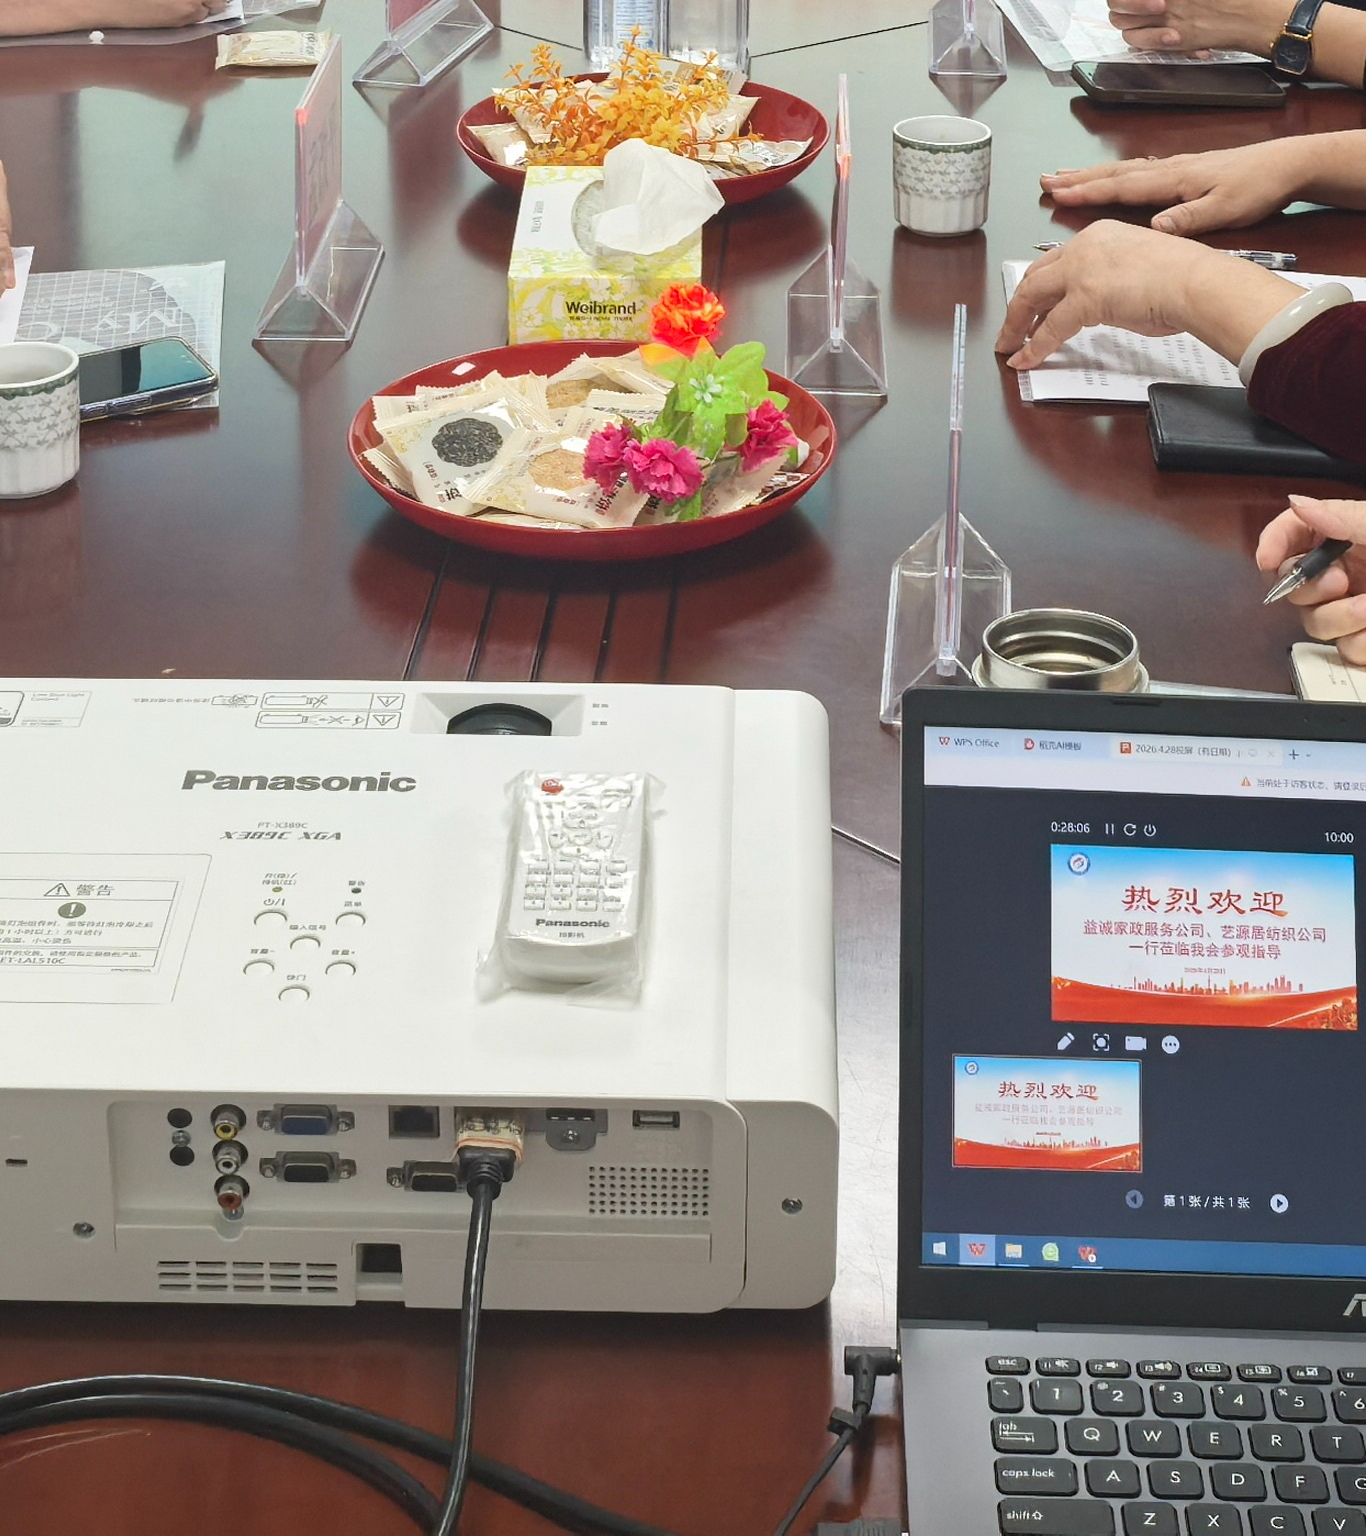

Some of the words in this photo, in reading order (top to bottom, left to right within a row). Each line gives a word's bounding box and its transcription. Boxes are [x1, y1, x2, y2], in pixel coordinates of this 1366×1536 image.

[566, 301, 636, 315] Weibrand
[974, 737, 1000, 749] Office
[182, 770, 417, 792] Panasonic
[1051, 822, 1090, 834] 0:28:06
[298, 831, 342, 841] XGA
[1324, 831, 1354, 844] 10:00
[76, 884, 115, 896] 警告
[1121, 885, 1289, 918] 热烈欢迎
[535, 919, 610, 928] Panasonic
[1083, 919, 1327, 943] 益诚家政服务公司、艺源居纺织公司
[1128, 941, 1282, 960] 一行莅临我会参观指导
[997, 1081, 1099, 1101] 热烈欢迎
[1053, 1388, 1059, 1399] 1
[1113, 1390, 1123, 1402] 2
[1173, 1392, 1183, 1403] 3
[1233, 1394, 1244, 1405] 4
[1294, 1396, 1304, 1407] 5
[1354, 1398, 1365, 1409] 6
[1083, 1427, 1100, 1441] Q
[1143, 1430, 1162, 1442] W
[1210, 1432, 1219, 1444] E
[1271, 1435, 1283, 1446] R
[1333, 1436, 1342, 1448] T
[1002, 1468, 1028, 1479] caps
[1031, 1467, 1055, 1478] lock
[1106, 1470, 1121, 1482] A
[1171, 1471, 1181, 1483] S
[1231, 1473, 1245, 1485] D
[1295, 1476, 1305, 1488] F
[1006, 1509, 1030, 1519] shift
[1144, 1512, 1156, 1525] Z
[1208, 1514, 1219, 1527] X
[1271, 1517, 1284, 1529] C
[1333, 1519, 1346, 1531] V
